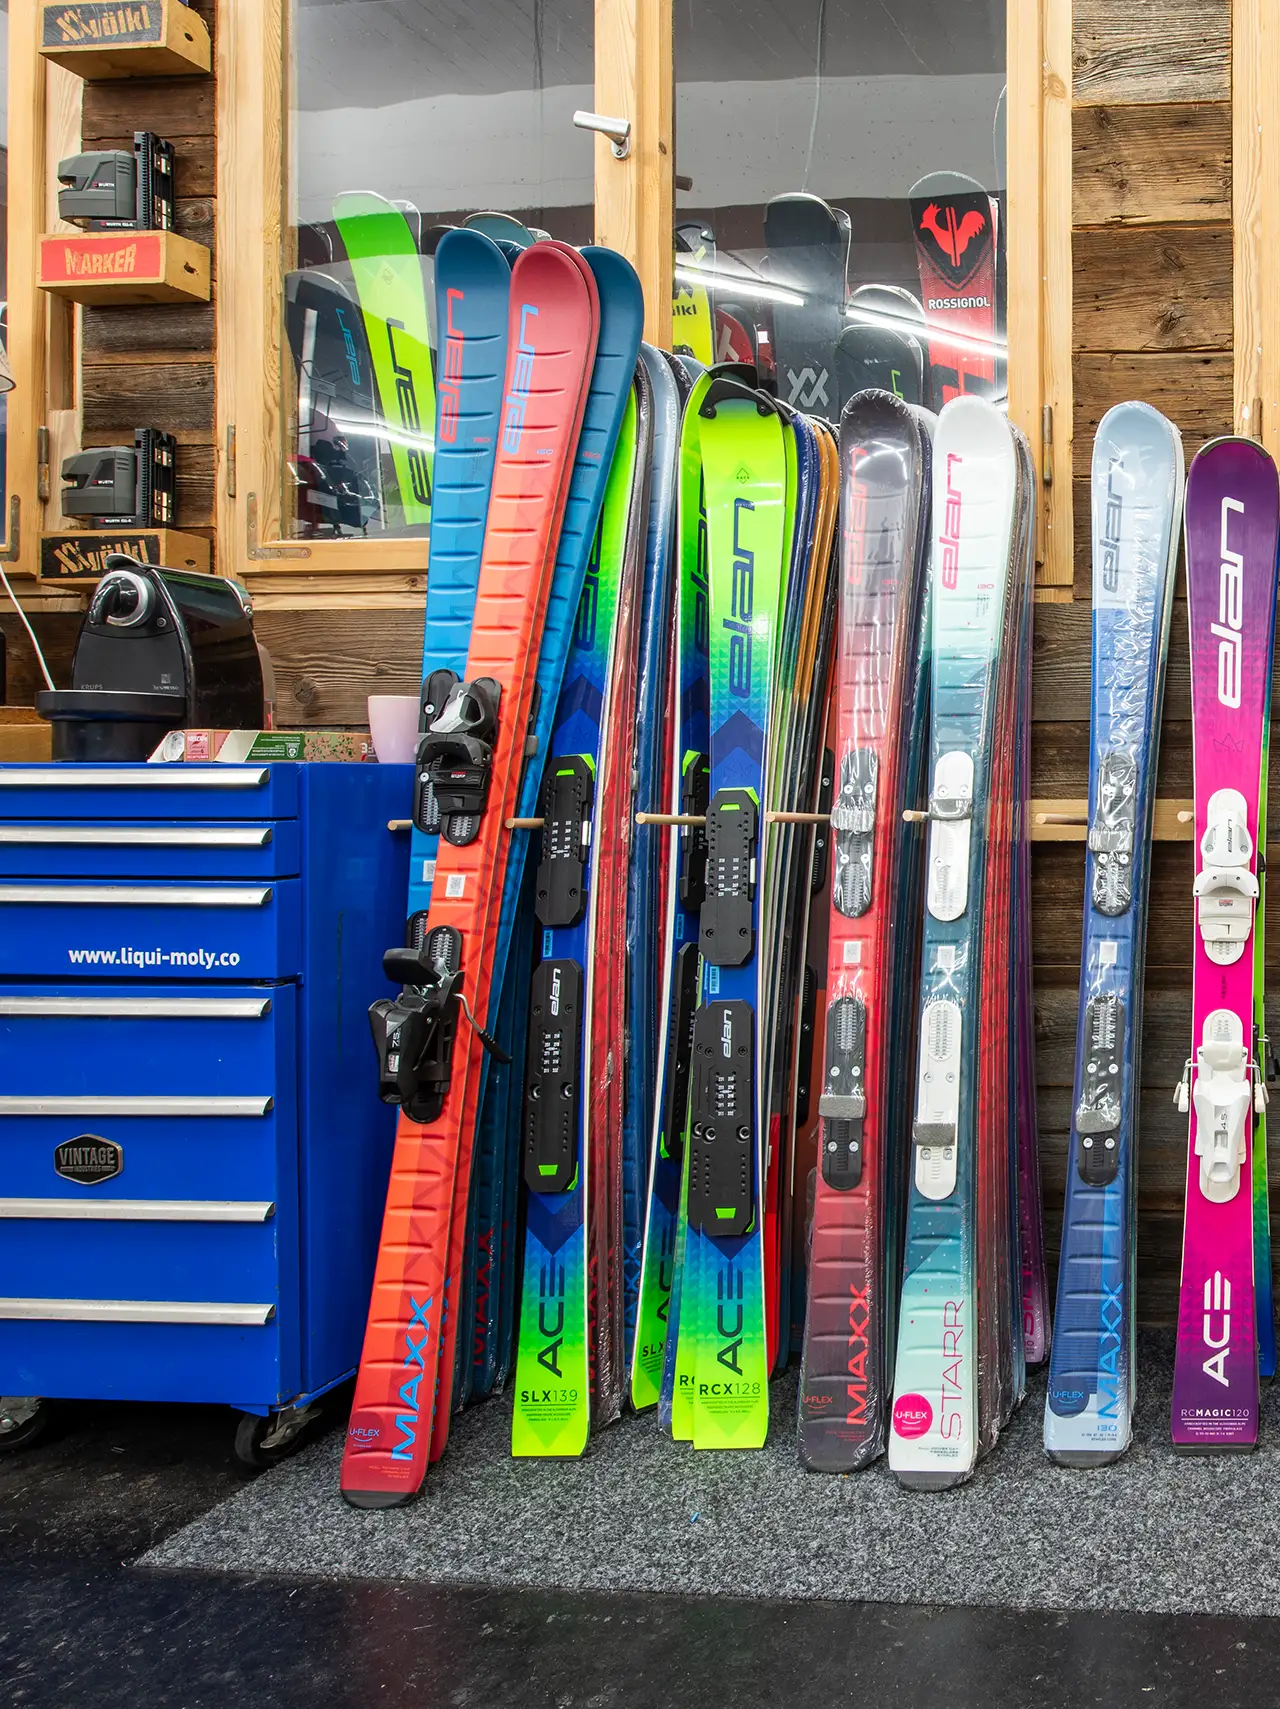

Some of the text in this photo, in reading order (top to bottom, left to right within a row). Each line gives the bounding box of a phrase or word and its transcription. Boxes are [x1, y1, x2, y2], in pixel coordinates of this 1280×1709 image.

[64, 243, 137, 276] MARKER
[928, 296, 991, 310] ROSSIGNOL
[335, 308, 361, 385] elan
[438, 288, 464, 443] elan
[503, 303, 539, 455] elan
[386, 317, 434, 507] elan
[844, 447, 867, 585] elan
[939, 453, 963, 590] elan
[1100, 457, 1124, 593] elan
[722, 497, 756, 698] elan
[1211, 496, 1245, 709] elan
[68, 947, 241, 970] www.liqui-moly.co
[549, 968, 562, 1016] elan
[722, 1009, 732, 1058] elan
[58, 1146, 116, 1166] VINTAGE
[537, 1256, 566, 1378] ACE
[717, 1260, 743, 1377] ACE
[846, 1283, 871, 1425] MAXX
[940, 1300, 965, 1441] STARR
[1097, 1280, 1124, 1419] MAXX
[1202, 1270, 1231, 1388] ACE
[390, 1296, 433, 1461] MAXX
[520, 1389, 578, 1402] SLX139
[699, 1382, 761, 1396] RCX128
[1180, 1408, 1250, 1417] RCMAGIC120
